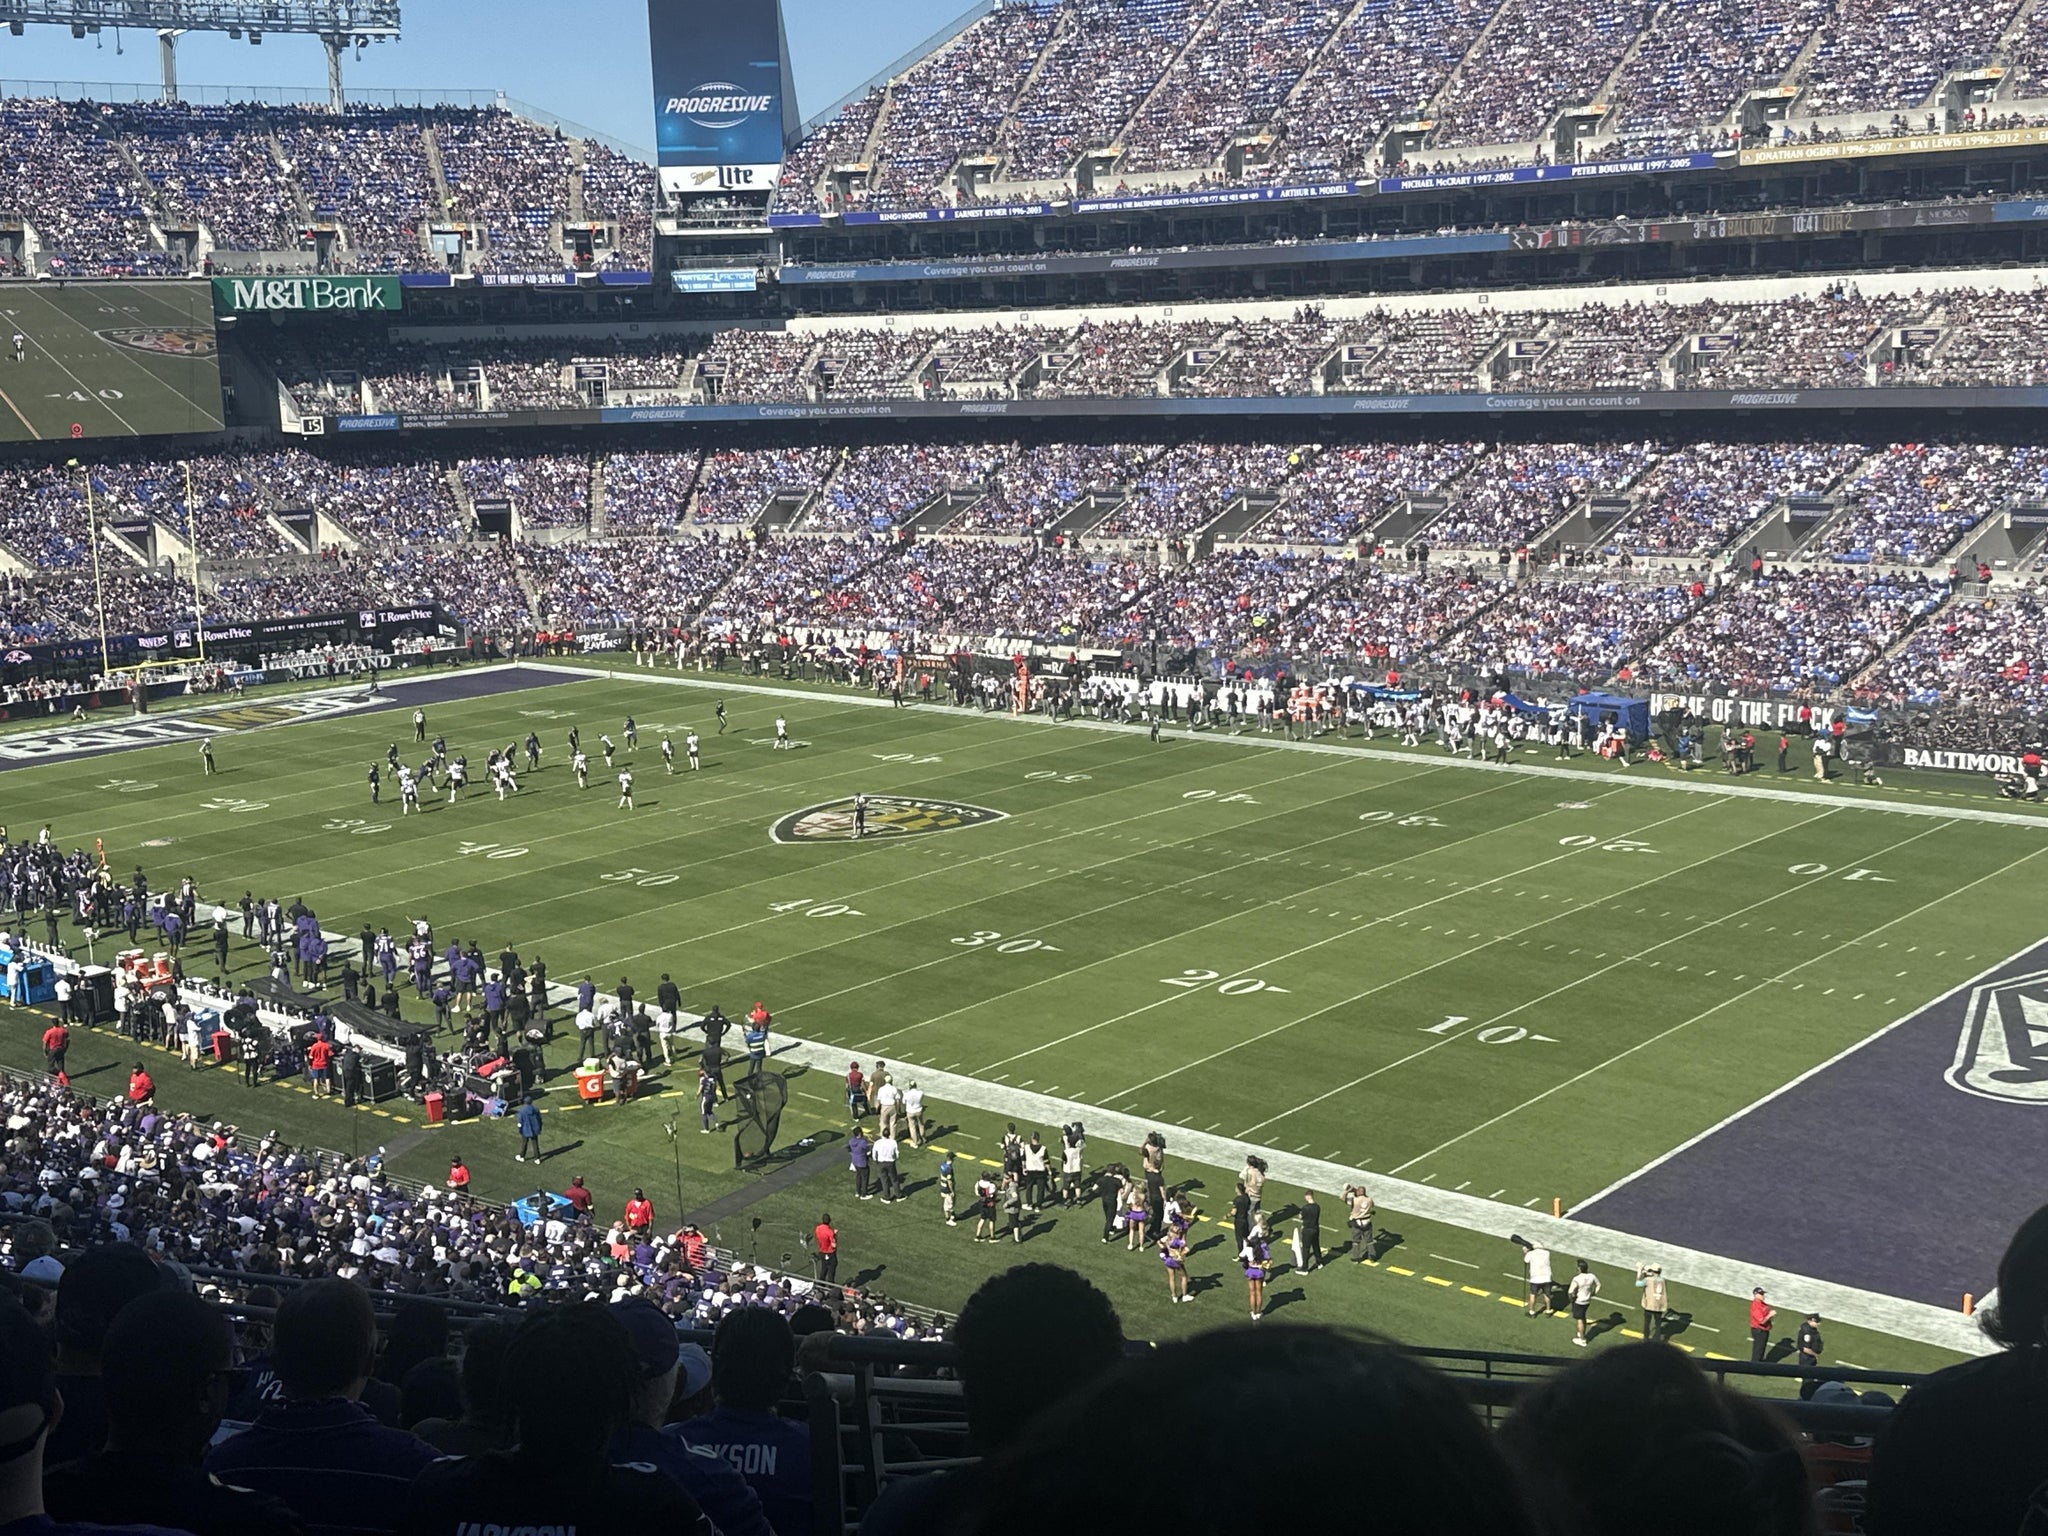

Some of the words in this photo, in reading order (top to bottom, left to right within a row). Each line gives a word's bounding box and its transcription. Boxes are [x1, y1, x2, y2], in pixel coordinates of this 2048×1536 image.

[665, 95, 771, 114] PROGRESSIVE
[1910, 139, 1930, 150] RAY
[1932, 137, 1962, 148] LEWIS
[1965, 133, 2020, 146] 1996-2012
[1755, 149, 1803, 164] JONATHAN
[1806, 146, 1838, 158] OGDEN
[1842, 142, 1892, 156] 1996-2007
[1571, 165, 1597, 177] PETER
[1599, 162, 1644, 174] BOULWARE
[1646, 158, 1691, 171] 1997-2005
[716, 166, 753, 190] Lite
[1401, 179, 1434, 190] MICHAEL
[1435, 176, 1471, 188] McCRARY
[1473, 173, 1515, 185] 1997-2002
[1280, 187, 1309, 198] ARTHUR
[1319, 185, 1348, 196] MODELL
[879, 213, 897, 221] RING
[901, 211, 928, 220] HONOR
[954, 209, 983, 219] EARNEST
[985, 207, 1007, 217] BYNER
[1008, 206, 1043, 216] 1996-2003
[1709, 225, 1717, 237] &
[1718, 221, 1726, 238] 8
[1792, 215, 1819, 233] 10:41
[1845, 213, 1852, 231] 2
[1557, 231, 1567, 247] 10
[1638, 226, 1645, 242] 3
[923, 265, 969, 277] Coverage
[969, 265, 987, 275] you
[987, 264, 1005, 273] can
[1006, 262, 1033, 272] count
[1034, 263, 1047, 271] on
[1110, 257, 1160, 268] PROGRESSIVE
[482, 275, 497, 285] TEXT
[805, 270, 857, 281] PROGRESSIVE
[231, 279, 310, 311] M&T
[312, 278, 386, 309] Bank
[1353, 399, 1411, 410] PROGRESSIVE
[1486, 396, 1541, 409] Coverage
[1542, 398, 1564, 409] you
[1565, 397, 1587, 407] can
[1588, 395, 1624, 406] count
[1625, 396, 1641, 406] on
[1730, 393, 1799, 405] PROGRESSIVE
[631, 409, 686, 420] PROGRESSIVE
[759, 406, 807, 418] Coverage
[808, 406, 827, 417] you
[828, 406, 847, 414] can
[849, 405, 877, 414] count
[879, 405, 892, 414] on
[960, 403, 1008, 414] PROGRESSIVE
[338, 417, 397, 430] PROGRESSIVE
[263, 625, 284, 633] INVEST
[288, 623, 305, 631] WITH
[306, 619, 345, 629] CONFIDENCE
[138, 635, 168, 649] RAVENS
[1711, 698, 1734, 724] OF
[1738, 700, 1772, 727] THE
[950, 930, 1043, 954] 30
[1159, 968, 1266, 995] 20
[1416, 1015, 1528, 1045] 10
[586, 1078, 600, 1092] G
